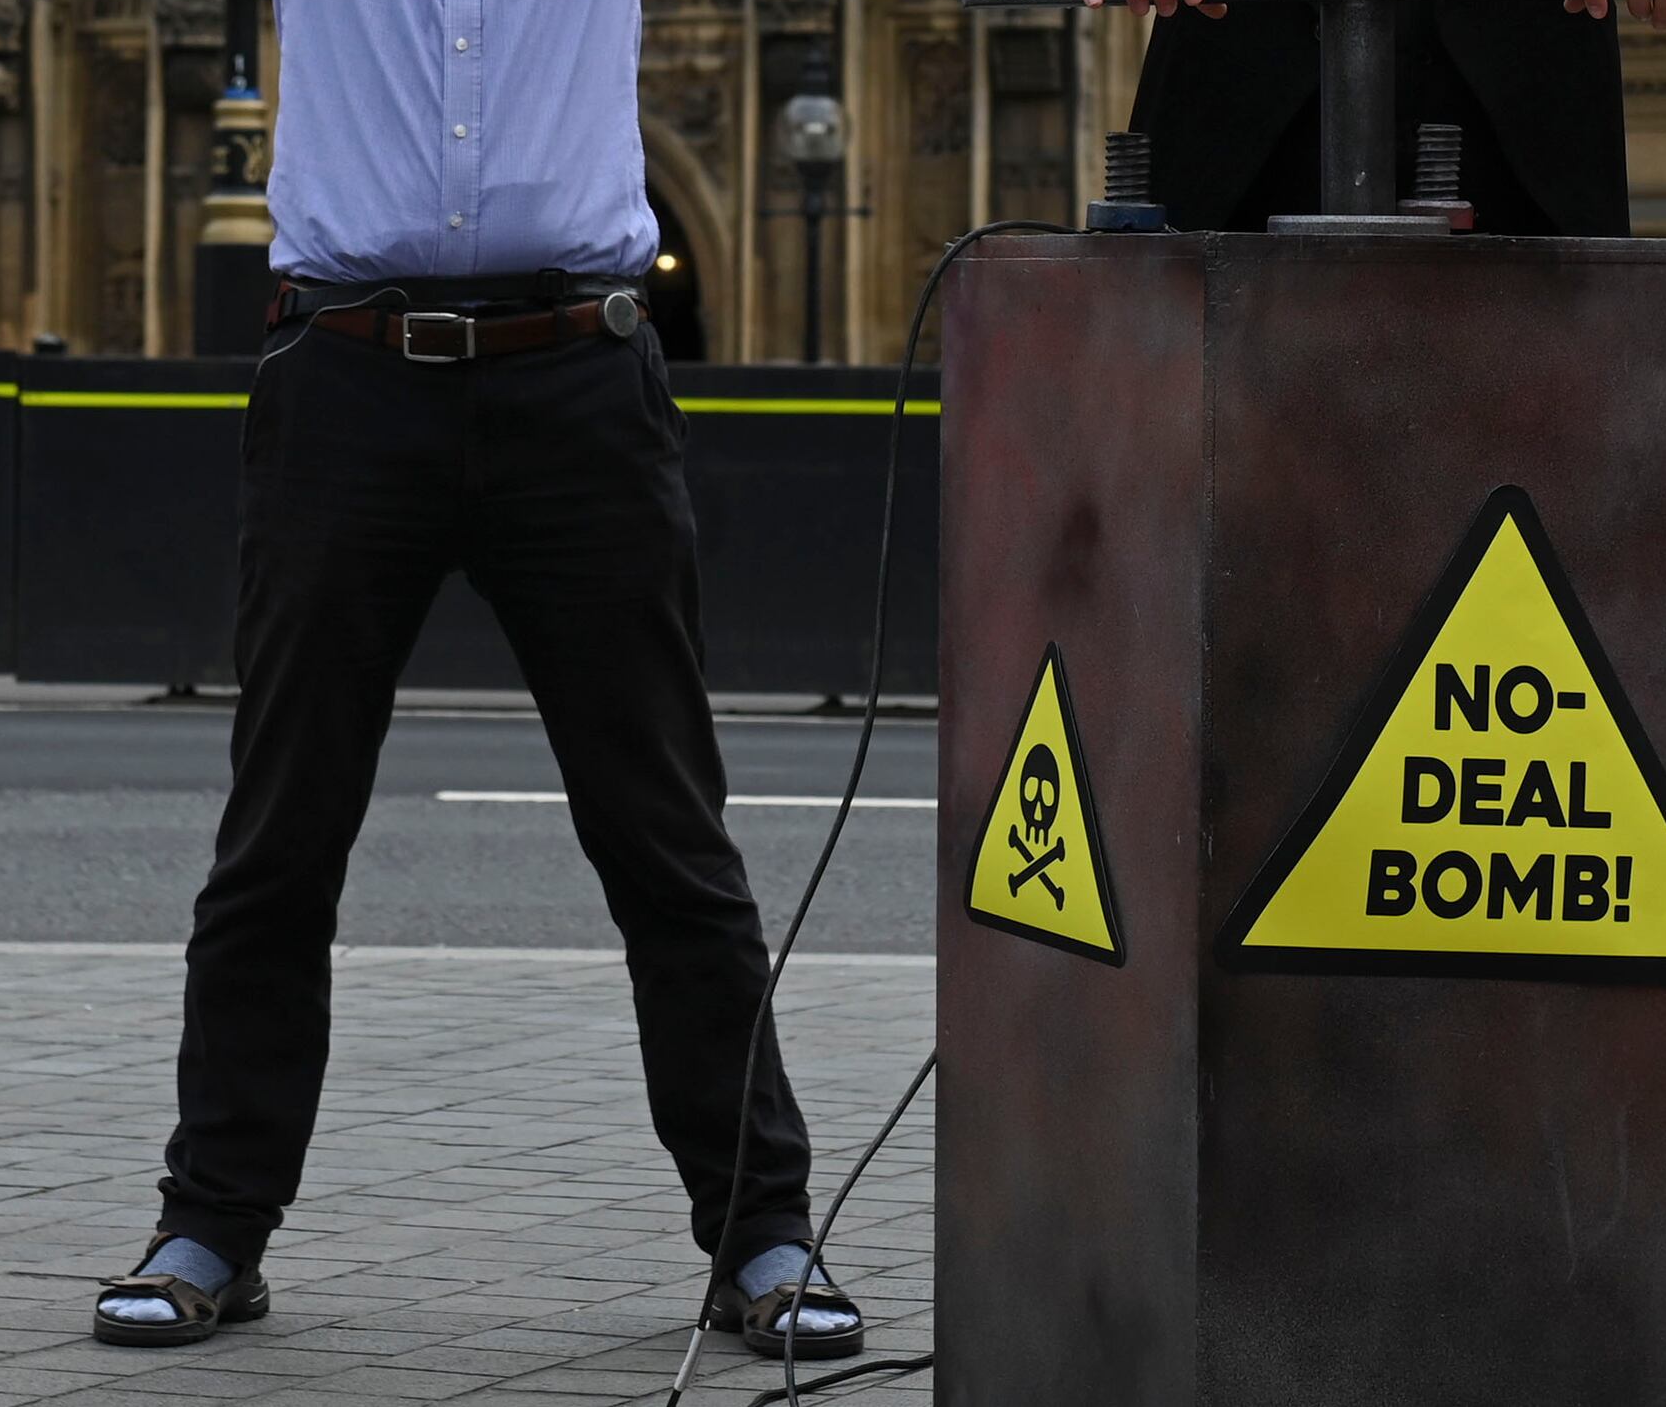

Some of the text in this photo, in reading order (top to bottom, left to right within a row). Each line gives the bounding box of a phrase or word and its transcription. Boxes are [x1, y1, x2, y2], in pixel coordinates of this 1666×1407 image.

[1434, 662, 1587, 735] NO-
[1401, 755, 1613, 830] DEAL
[1365, 848, 1634, 924] BOMB!
